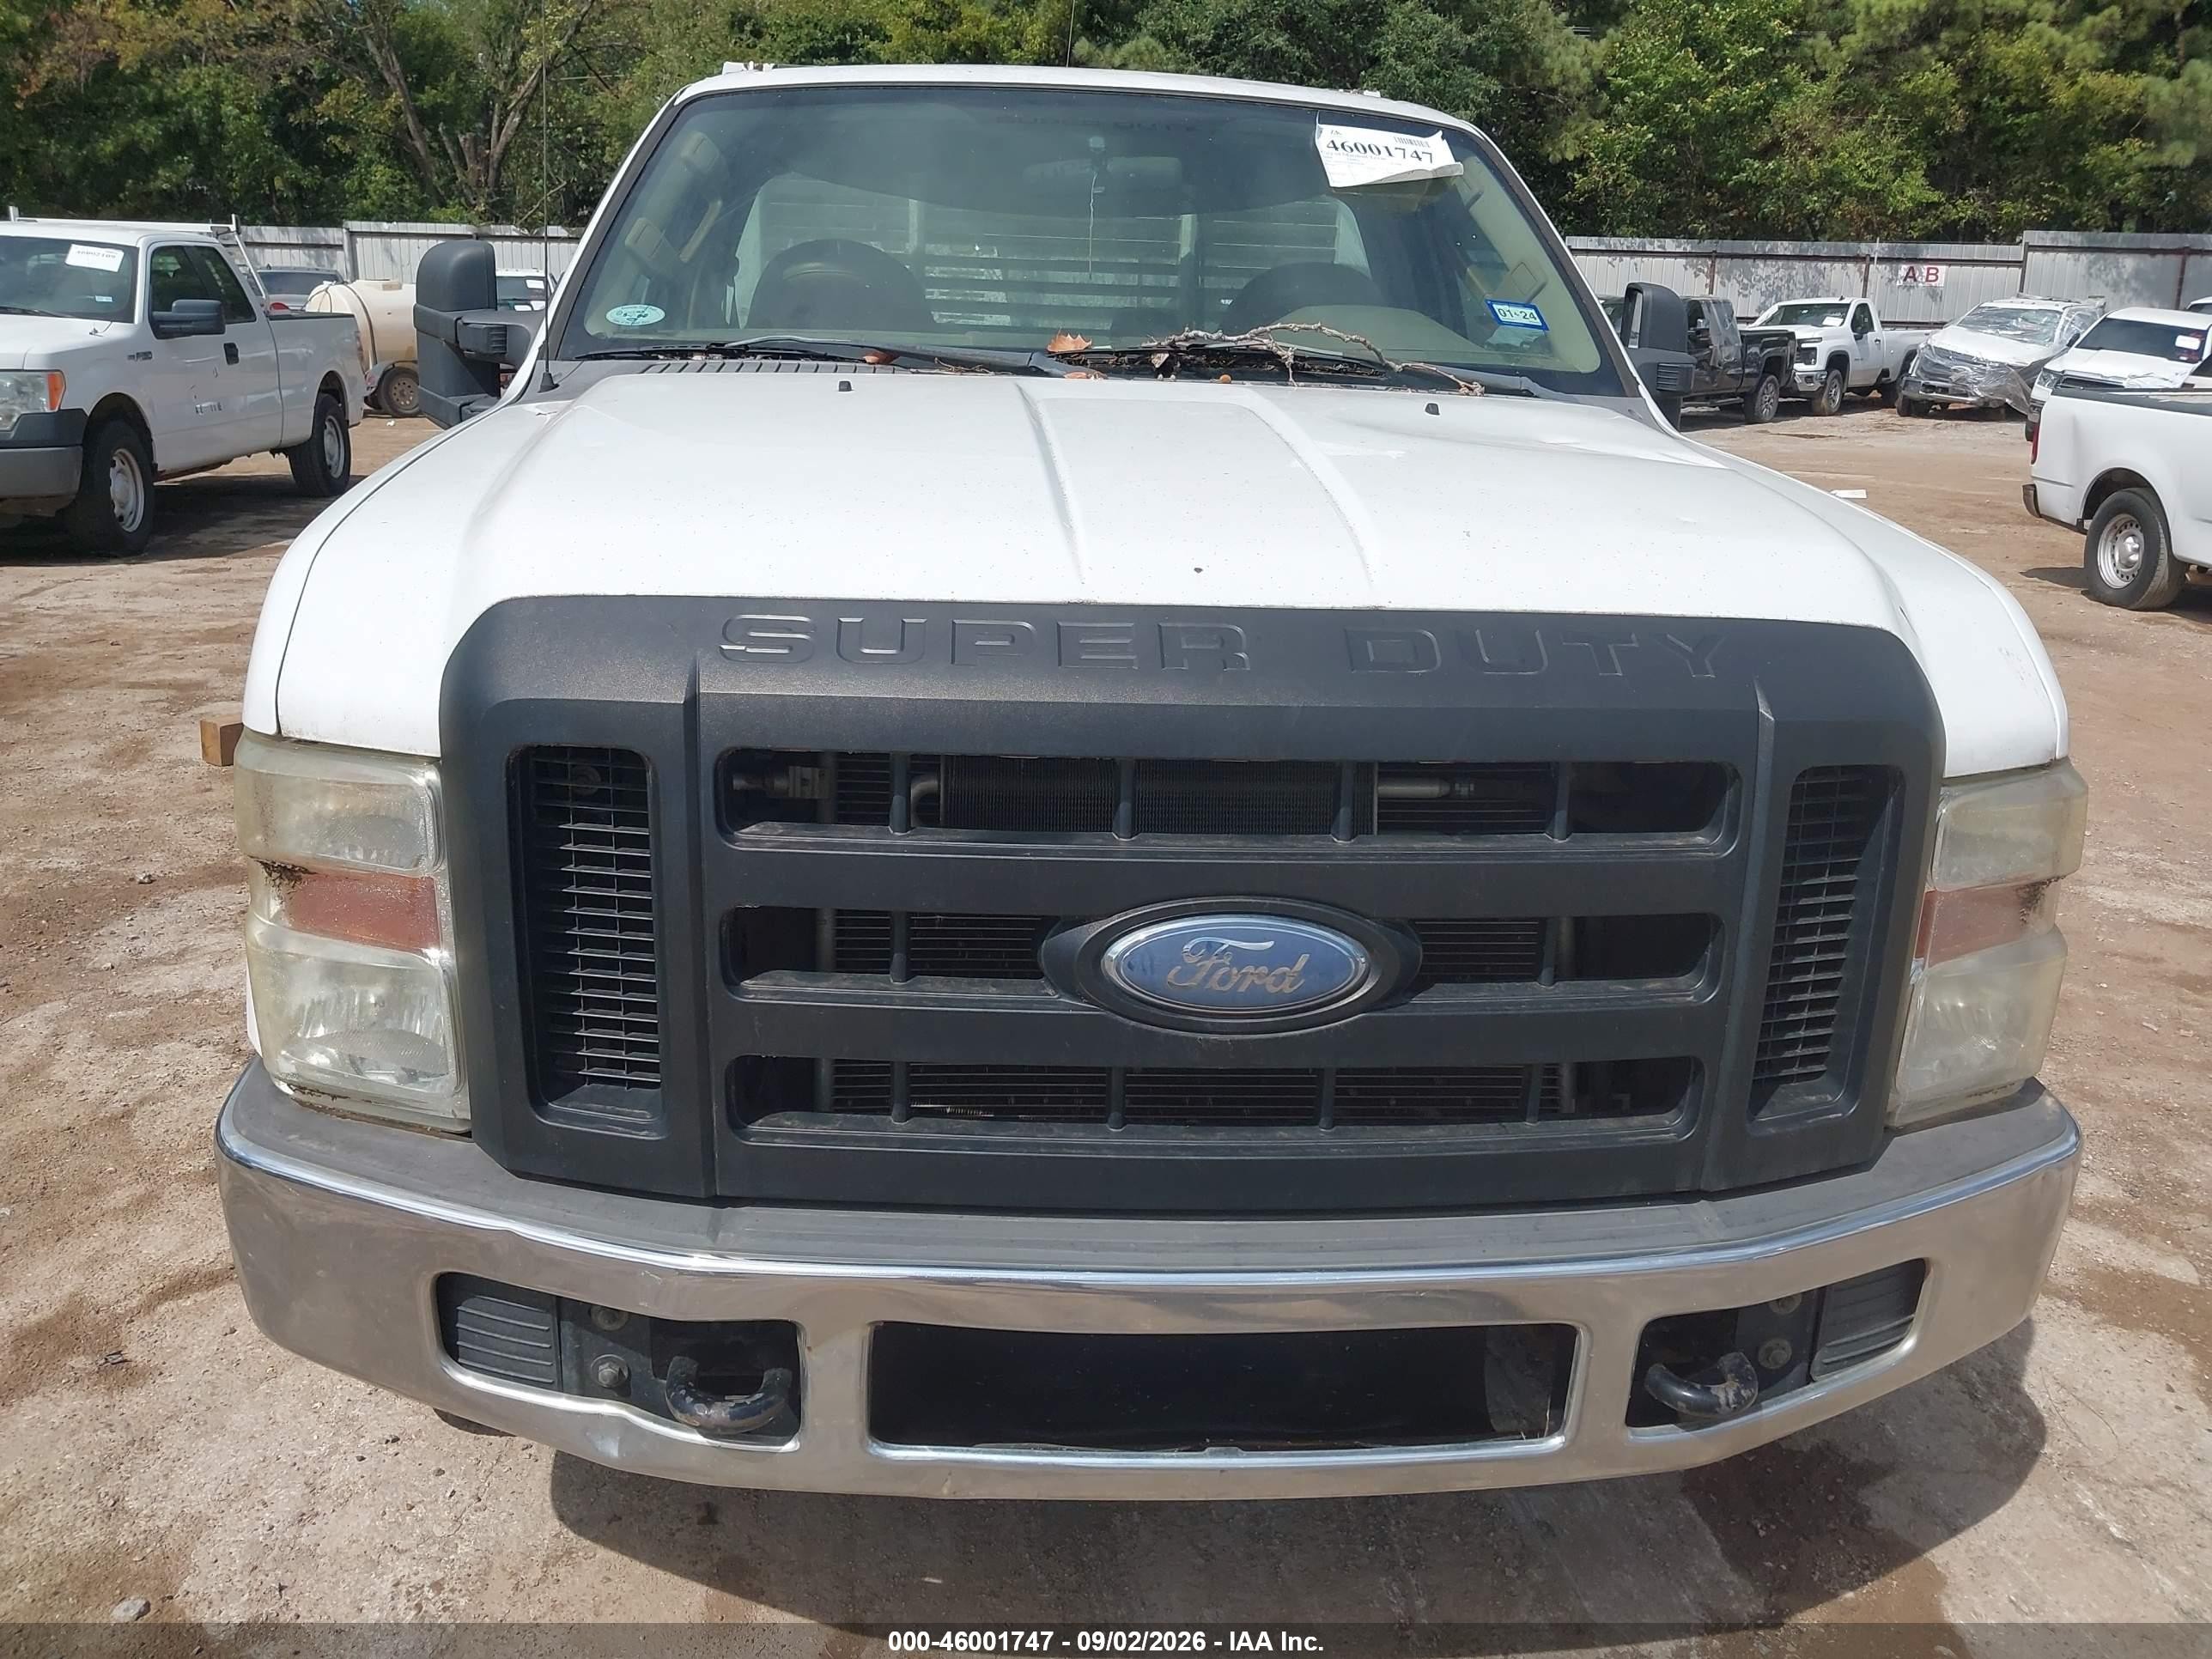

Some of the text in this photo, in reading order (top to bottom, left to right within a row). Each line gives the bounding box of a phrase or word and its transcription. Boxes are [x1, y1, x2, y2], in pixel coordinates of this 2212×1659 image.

[1326, 139, 1433, 164] 46001747
[719, 614, 1726, 678] SUPER DUTY
[1167, 936, 1310, 994] Ford
